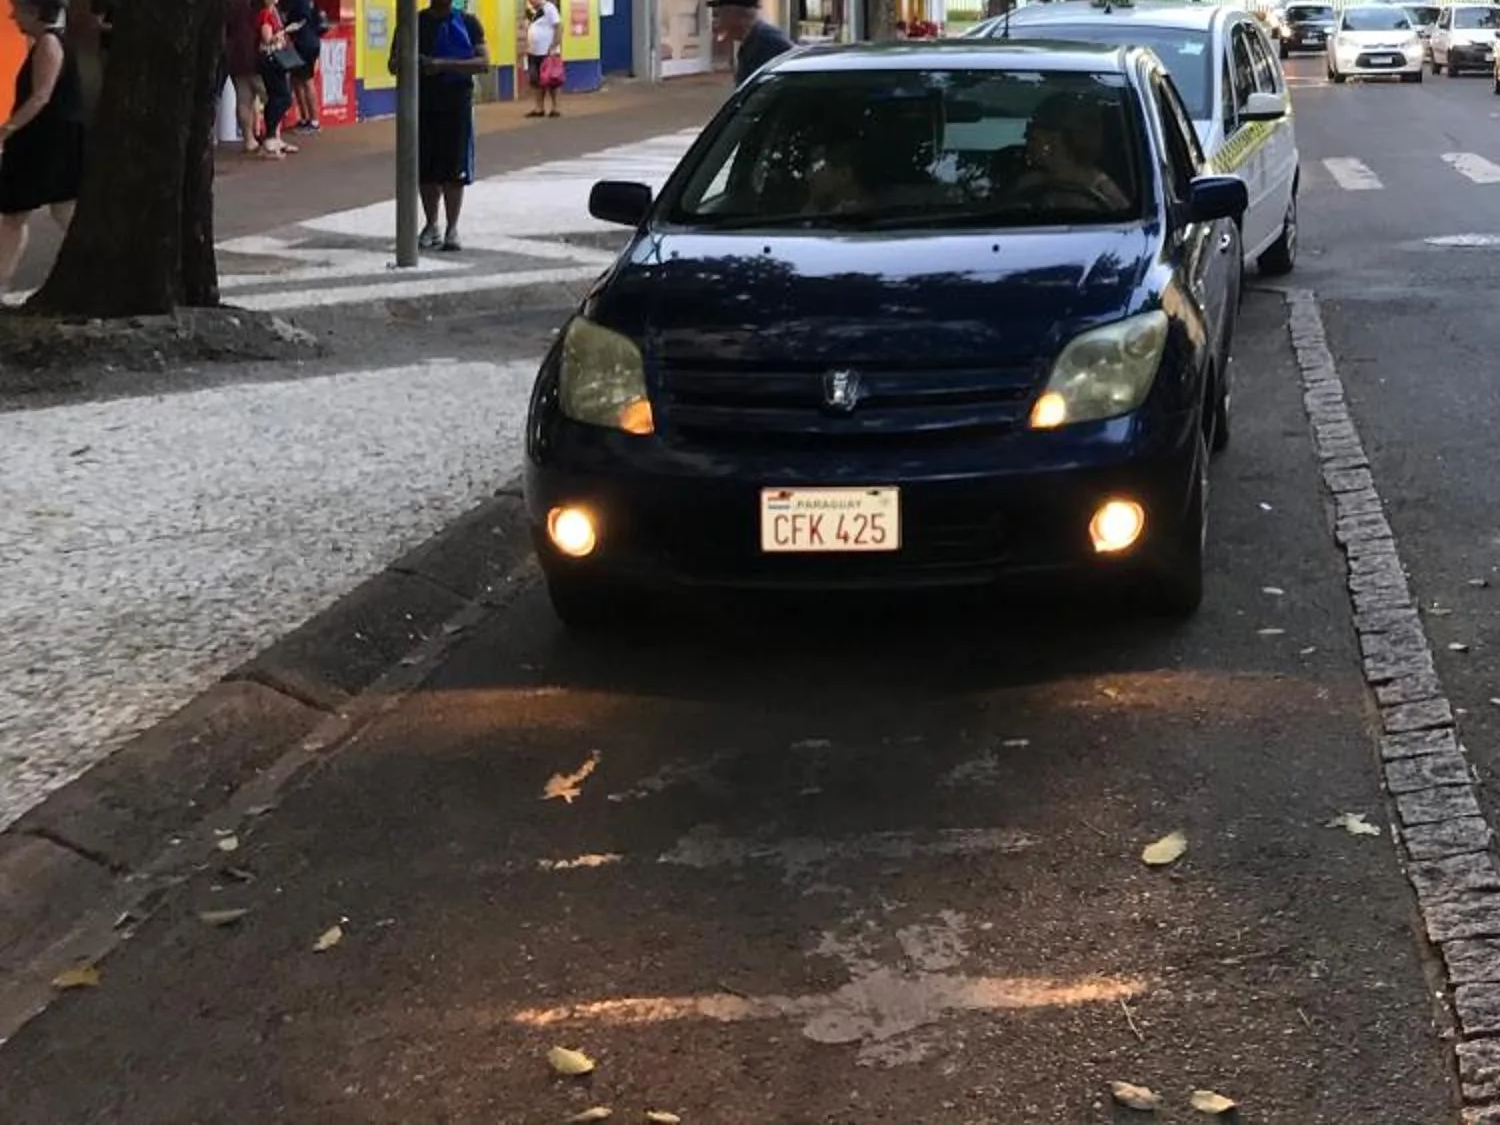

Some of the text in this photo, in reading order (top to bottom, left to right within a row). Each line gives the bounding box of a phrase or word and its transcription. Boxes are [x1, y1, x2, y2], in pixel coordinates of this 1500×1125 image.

[797, 500, 862, 509] PARAGUAY
[773, 514, 887, 545] CFK 425
